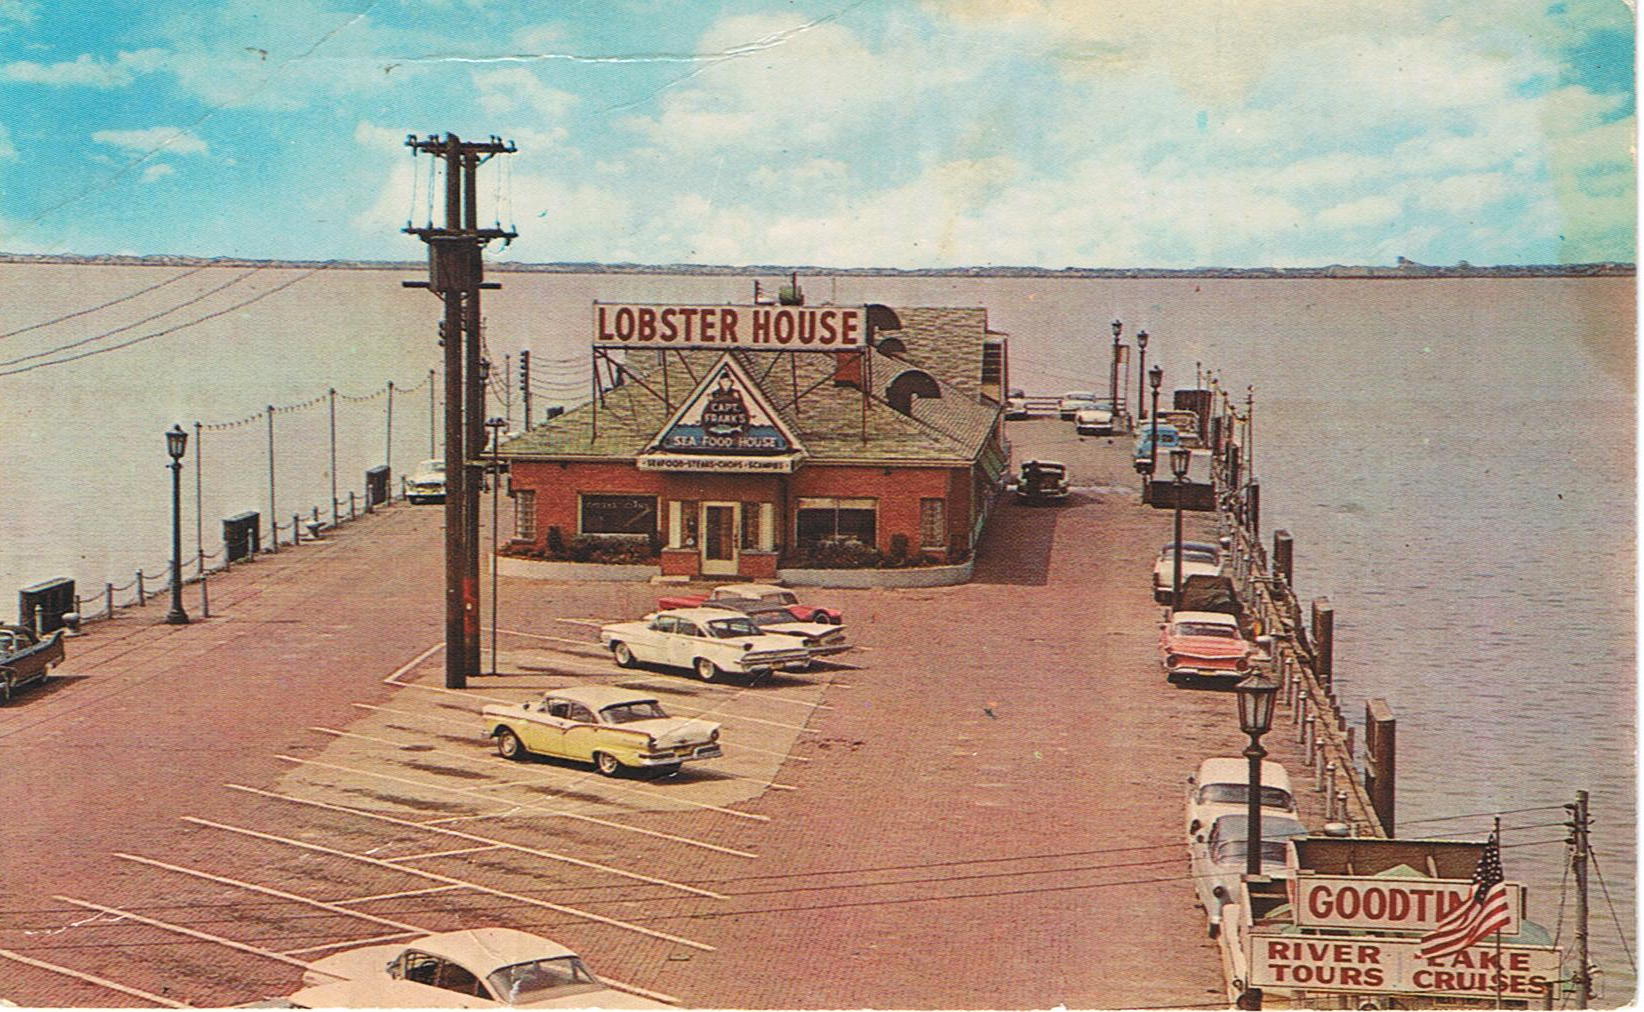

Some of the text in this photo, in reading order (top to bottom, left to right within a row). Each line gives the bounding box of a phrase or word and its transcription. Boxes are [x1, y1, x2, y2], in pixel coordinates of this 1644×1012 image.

[599, 307, 858, 345] LOBSTER HOUSE
[673, 435, 777, 448] SEA FOOD HOUSE
[1268, 941, 1381, 964] RIVER
[1268, 964, 1384, 986] TOURS
[1412, 969, 1547, 994] CRUISES
